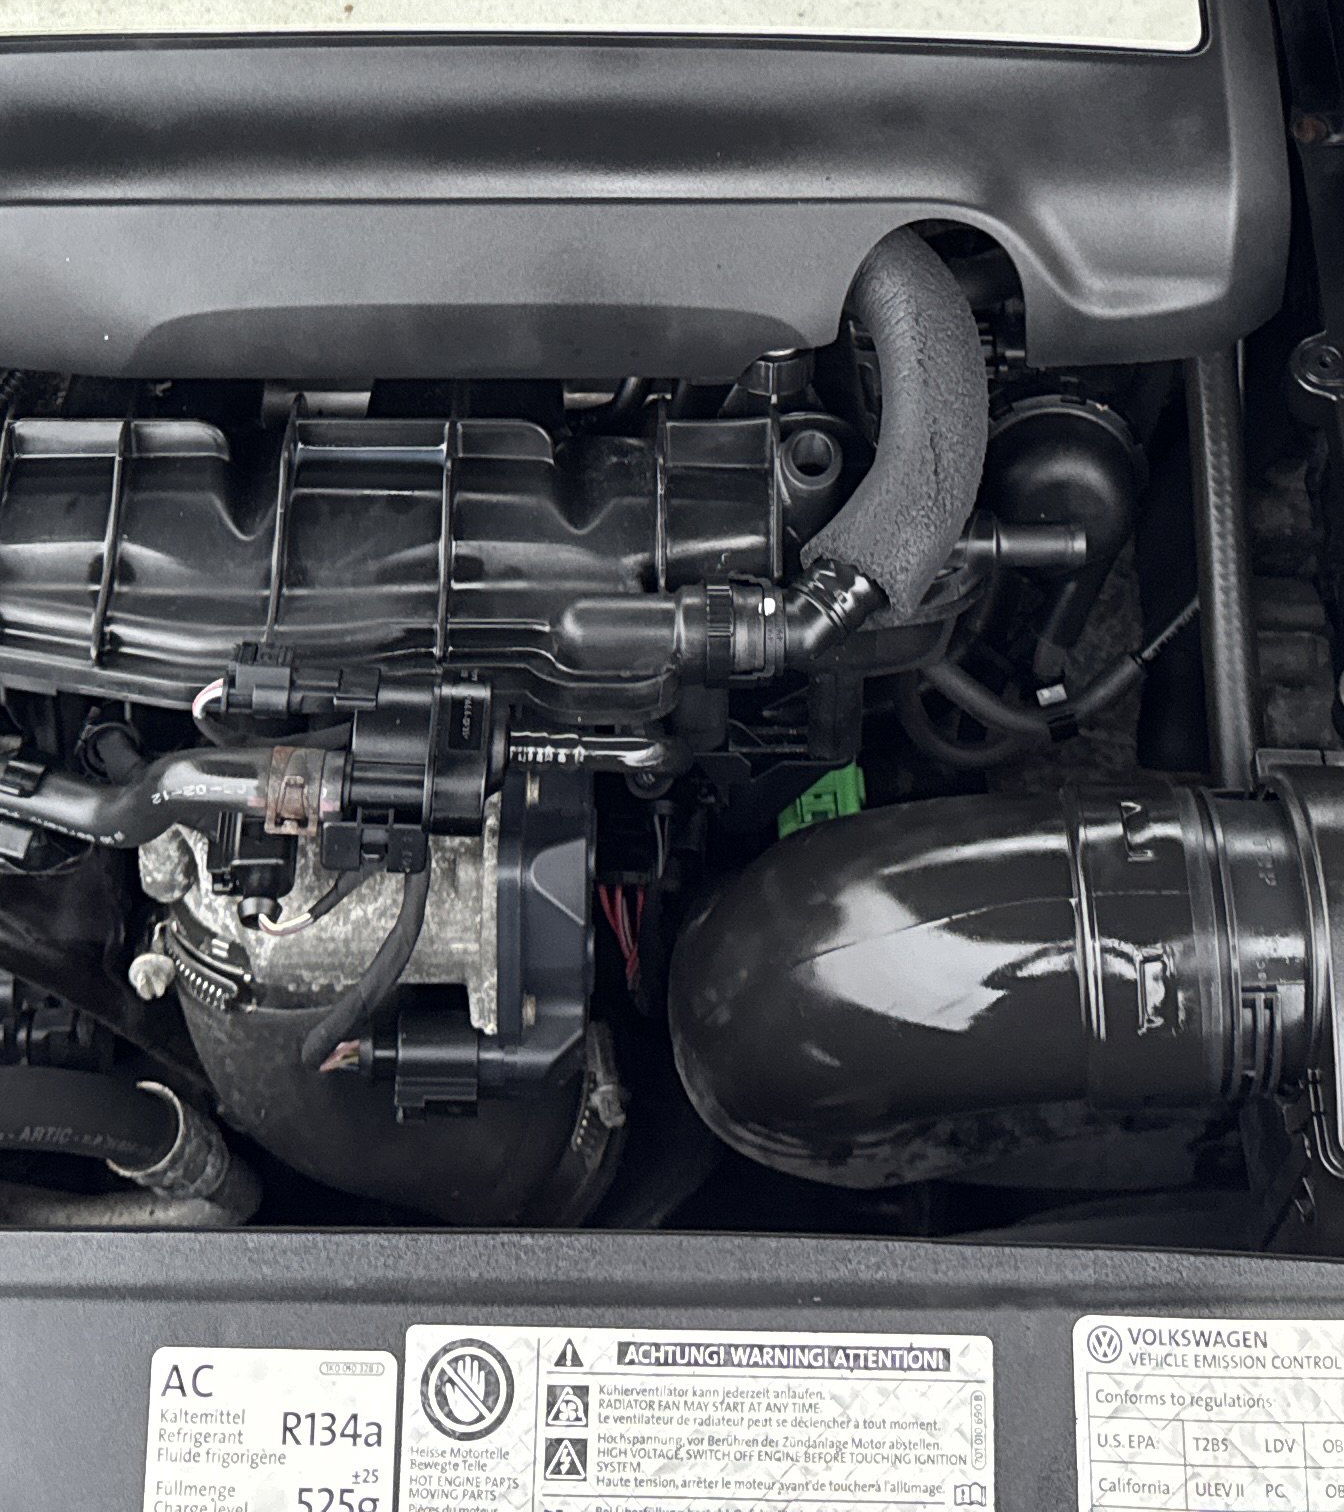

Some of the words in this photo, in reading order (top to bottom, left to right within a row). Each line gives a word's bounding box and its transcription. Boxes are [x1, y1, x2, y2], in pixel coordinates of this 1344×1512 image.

[1127, 1327, 1268, 1348] VOLKSWAGEN
[624, 1345, 726, 1367] ACHTUNG!
[731, 1347, 830, 1368] WARNING!
[833, 1348, 946, 1370] ATTENTION!
[1129, 1352, 1189, 1368] VEHICLE
[1194, 1354, 1267, 1370] EMISSION
[1271, 1355, 1342, 1370] CONTROL
[161, 1364, 214, 1397] AC
[692, 1385, 719, 1398] kann
[772, 1386, 826, 1400] anlaufen.
[1095, 1389, 1166, 1407] Conforms
[1171, 1391, 1186, 1407] to
[598, 1398, 656, 1411] RADIATOR
[657, 1400, 680, 1412] FAN
[683, 1400, 709, 1412] MAY
[712, 1401, 746, 1413] START
[748, 1402, 762, 1413] AT
[765, 1402, 789, 1414] ANY
[791, 1402, 823, 1414] TIME.
[281, 1411, 383, 1447] R134a
[598, 1412, 610, 1424] Le
[613, 1412, 673, 1425] ventilateur
[676, 1414, 691, 1426] de
[693, 1414, 745, 1427] radiateur
[747, 1416, 773, 1430] peut
[775, 1419, 788, 1428] se
[790, 1416, 851, 1429] déclencher
[853, 1417, 860, 1430] à
[862, 1418, 887, 1430] tout
[889, 1419, 942, 1432] moment.
[158, 1427, 244, 1448] Refrigerant
[597, 1432, 686, 1450] Hochspannung,
[686, 1437, 705, 1447] vor
[707, 1434, 759, 1448] Berühren
[761, 1436, 779, 1448] der
[851, 1437, 887, 1450] Motor
[888, 1438, 943, 1452] abstellen.
[1097, 1433, 1126, 1449] U.S.
[1264, 1438, 1296, 1454] LDV
[157, 1446, 201, 1464] Fluide
[205, 1448, 287, 1469] frigorigène
[597, 1446, 628, 1459] HIGH
[630, 1448, 684, 1462] VOLTAGE,
[686, 1449, 731, 1461] SWITCH
[733, 1450, 755, 1462] OFF
[757, 1451, 801, 1463] ENGINE
[804, 1452, 846, 1464] BEFORE
[849, 1453, 912, 1465] TOUCHING
[914, 1454, 968, 1466] IGNITION
[409, 1459, 460, 1474] Bewegte
[351, 1468, 379, 1485] ±25
[409, 1474, 433, 1487] HOT
[437, 1476, 482, 1488] ENGINE
[485, 1477, 520, 1490] PARTS
[596, 1475, 631, 1488] Haute
[633, 1476, 679, 1490] tension,
[680, 1476, 719, 1489] arrêter
[722, 1477, 732, 1489] le
[734, 1479, 776, 1491] moteur
[778, 1481, 810, 1493] avant
[814, 1480, 827, 1492] de
[408, 1488, 459, 1500] MOVING
[462, 1489, 497, 1501] PARTS
[1195, 1481, 1232, 1498] ULEV
[1265, 1484, 1285, 1499] PC
